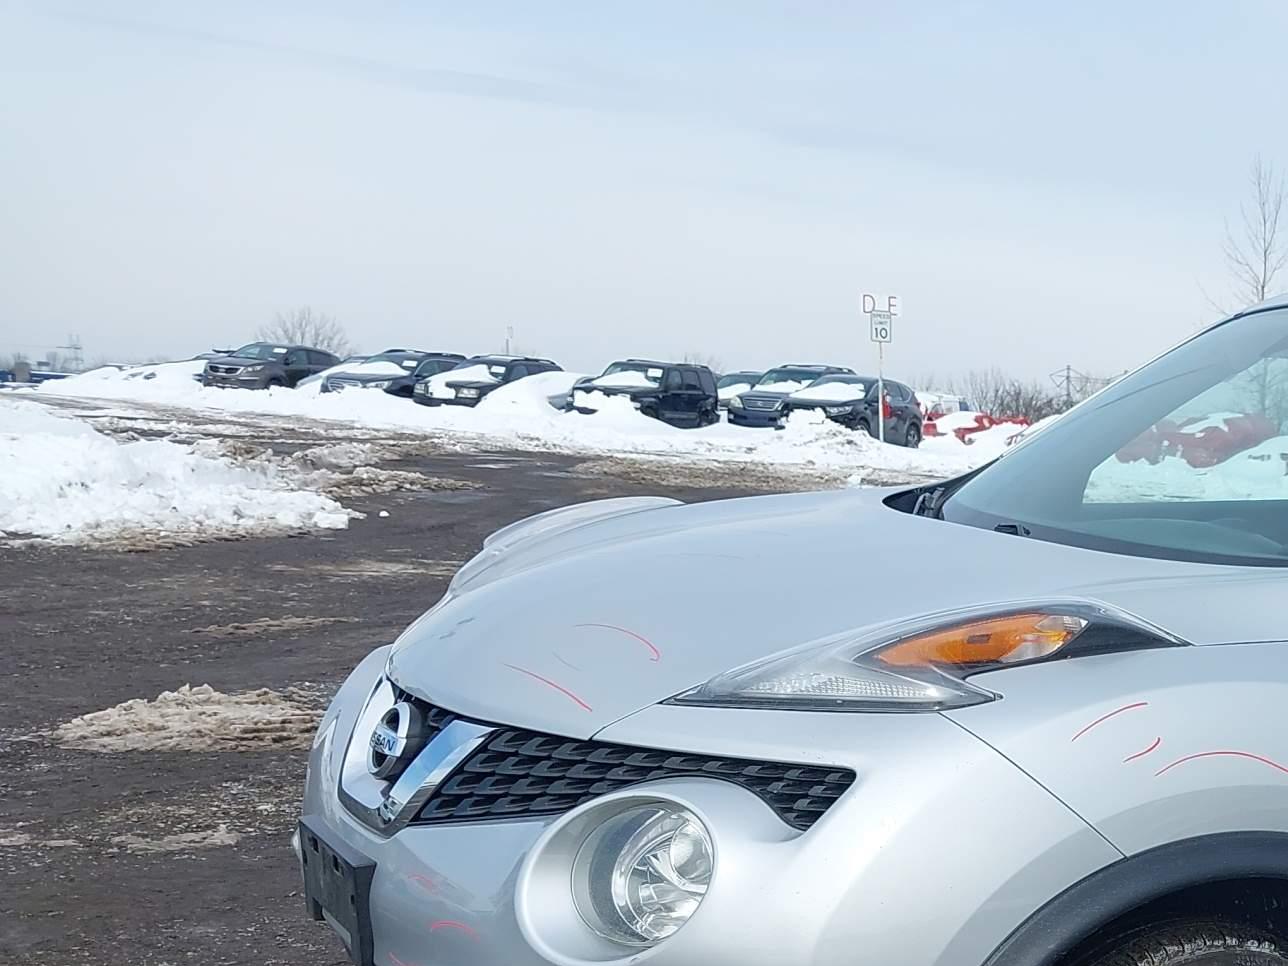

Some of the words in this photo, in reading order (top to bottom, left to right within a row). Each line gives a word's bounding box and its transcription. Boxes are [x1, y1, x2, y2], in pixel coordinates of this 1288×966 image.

[863, 294, 876, 313] D
[888, 296, 897, 316] E
[874, 327, 888, 339] 10
